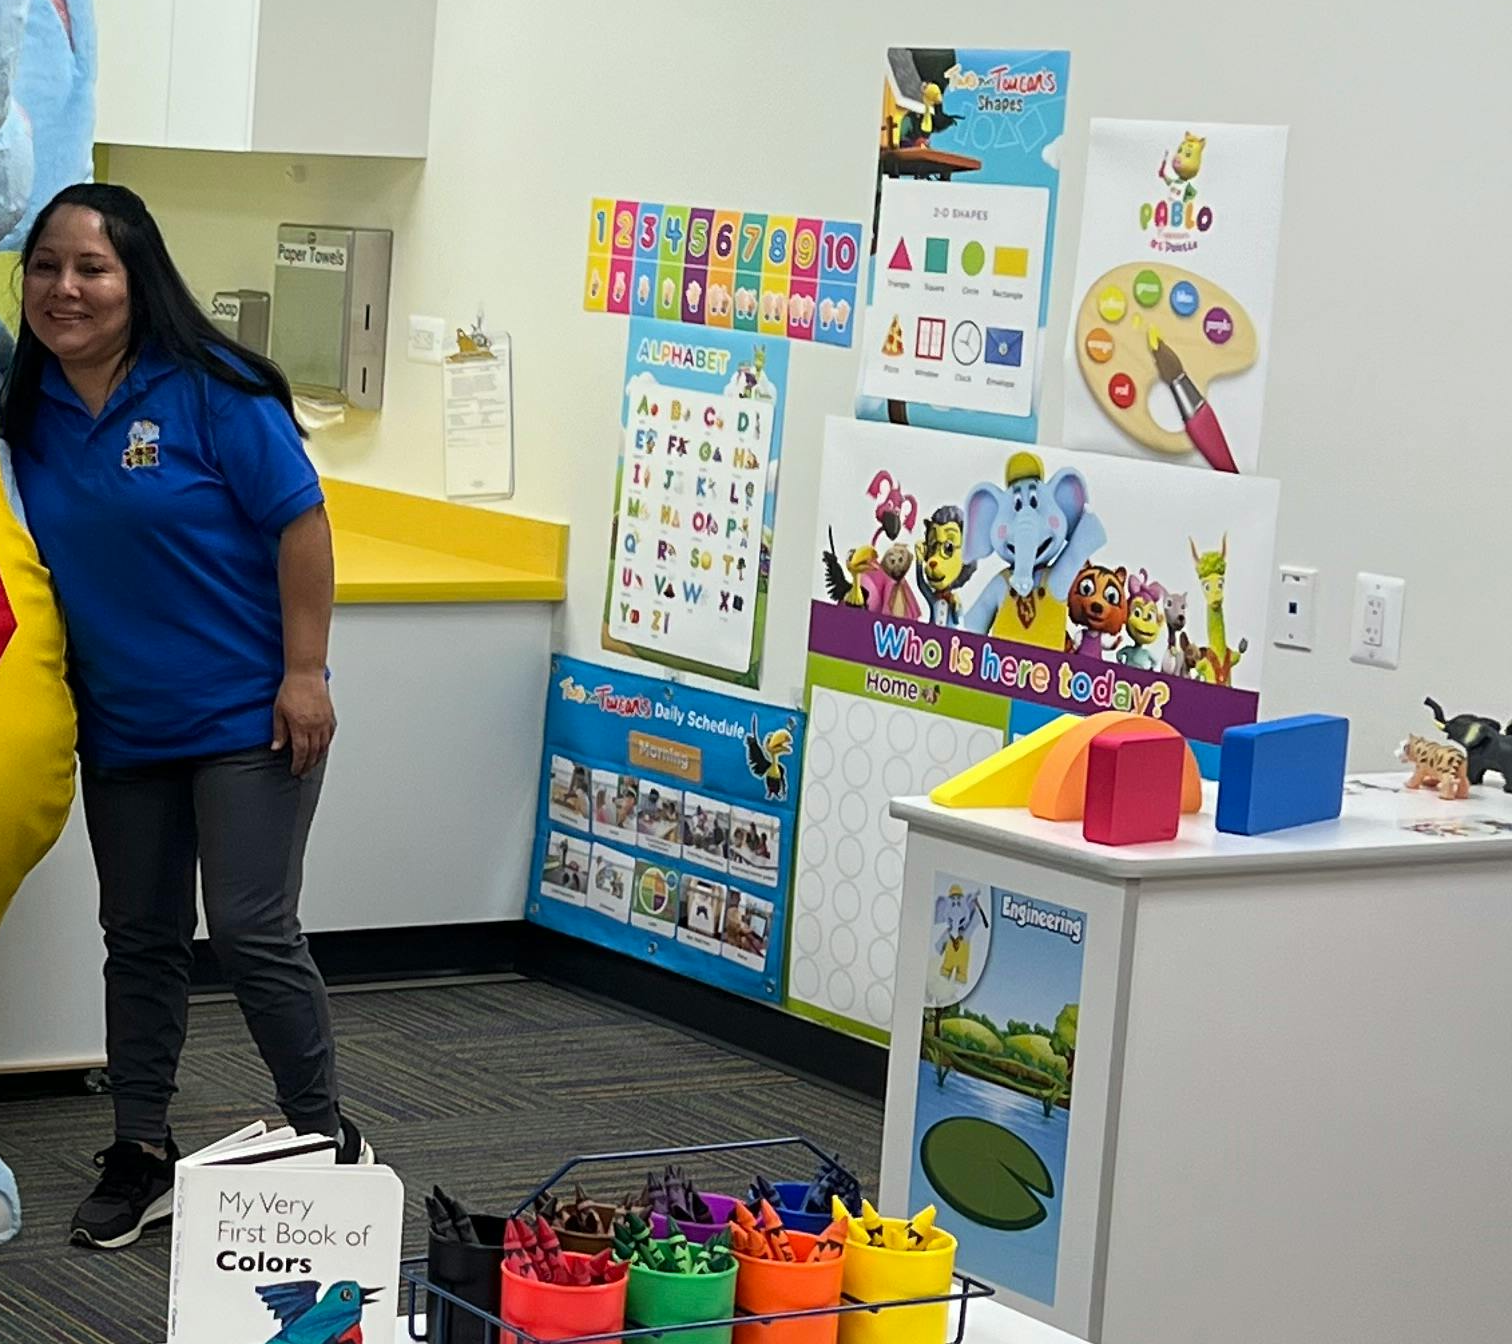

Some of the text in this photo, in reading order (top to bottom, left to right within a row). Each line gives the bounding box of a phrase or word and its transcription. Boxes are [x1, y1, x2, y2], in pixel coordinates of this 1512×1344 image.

[978, 95, 1023, 113] Shapes
[952, 209, 988, 220] SHAPES
[1140, 200, 1213, 232] PABLO
[278, 243, 345, 266] Paper Towels
[596, 211, 857, 272] 1 2 3 4 5 6 7 8 9 10
[211, 297, 238, 319] Soap
[638, 338, 730, 374] ALPHABET
[637, 394, 649, 416] A
[704, 406, 716, 426] C
[738, 412, 749, 432] D
[635, 430, 645, 449] E
[668, 435, 677, 454] F
[663, 469, 674, 490] J
[696, 476, 706, 496] K
[730, 482, 739, 504] L
[693, 511, 704, 531] O
[726, 518, 737, 538] P
[624, 534, 734, 576] Q R S T
[622, 567, 730, 612] U V W X
[620, 602, 630, 622] Y
[873, 620, 1171, 719] Who is here today?
[865, 671, 919, 702] Home
[655, 703, 685, 727] Daily
[687, 710, 745, 739] Schedule
[638, 740, 690, 769] Morning
[1002, 894, 1082, 943] Engineering
[219, 1191, 314, 1222] My Very
[218, 1220, 372, 1247] First Book of
[216, 1250, 312, 1274] Colors
